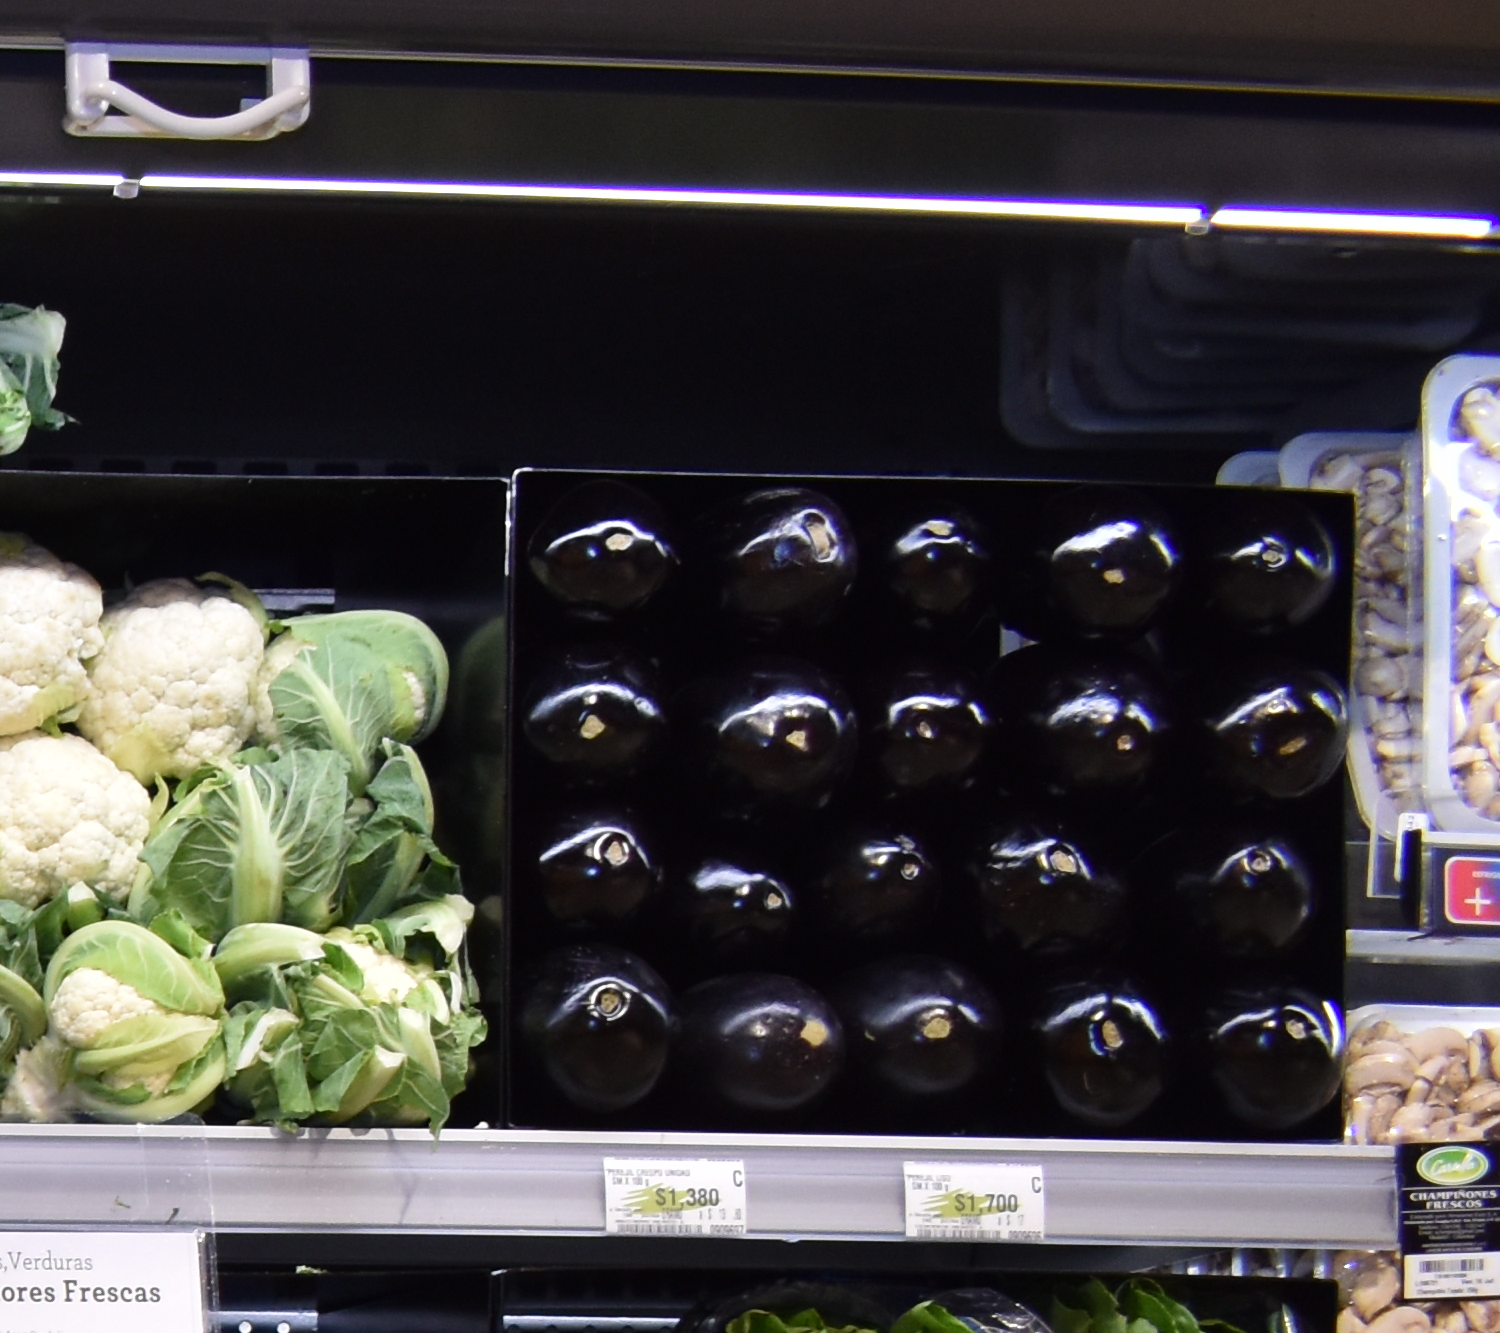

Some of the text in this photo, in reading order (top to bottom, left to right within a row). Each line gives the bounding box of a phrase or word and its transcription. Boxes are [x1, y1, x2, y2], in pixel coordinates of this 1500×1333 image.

[733, 1170, 743, 1187] C
[1032, 1177, 1041, 1192] C
[656, 1188, 719, 1206] $1,380
[955, 1194, 1018, 1212] $1,700
[1410, 1189, 1497, 1201] CHAMPIÑONES
[1426, 1200, 1482, 1209] FRESCOS
[64, 1280, 160, 1303] Frescas
